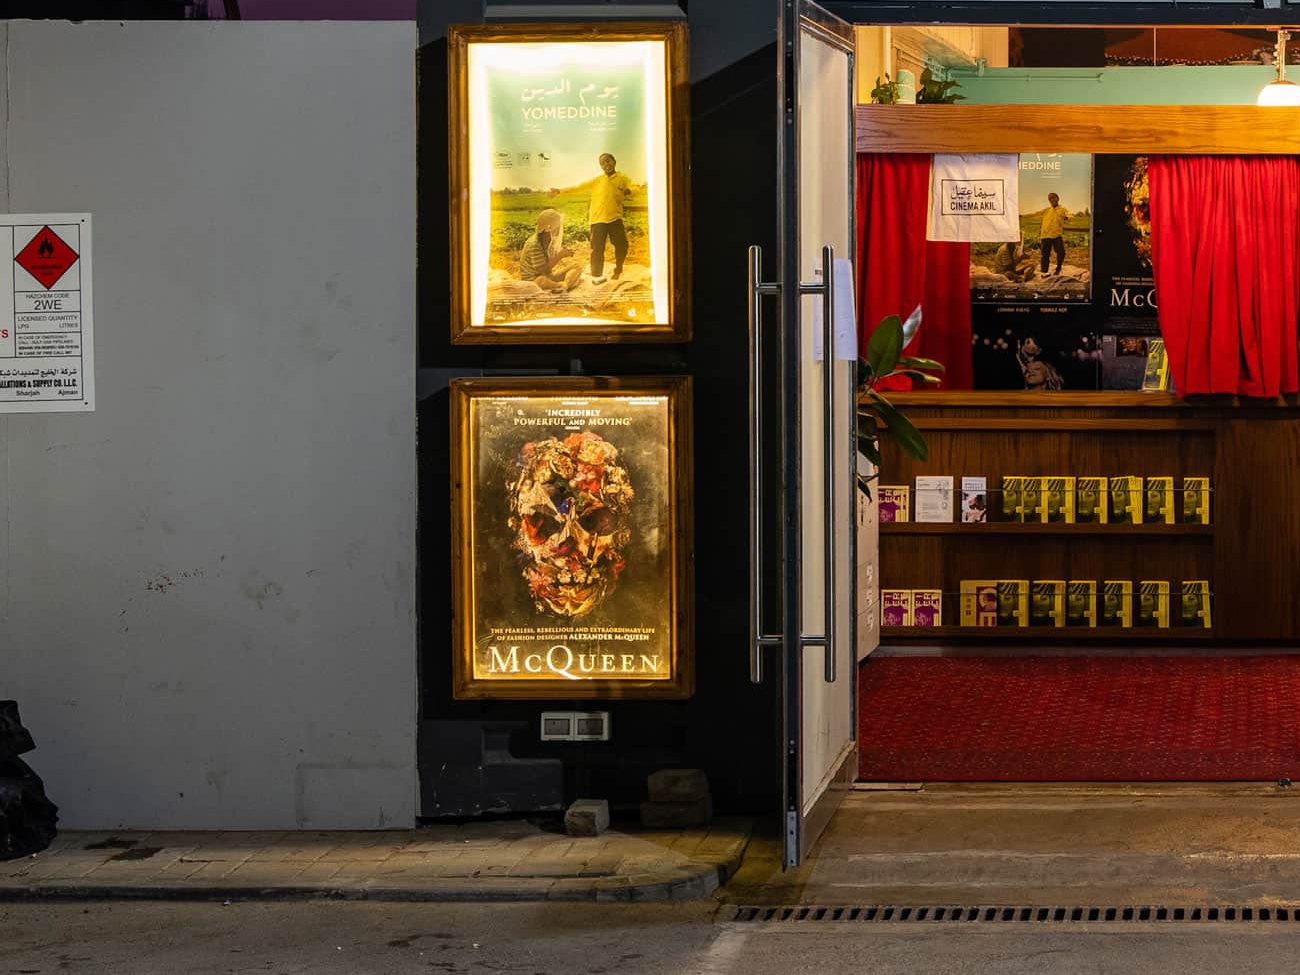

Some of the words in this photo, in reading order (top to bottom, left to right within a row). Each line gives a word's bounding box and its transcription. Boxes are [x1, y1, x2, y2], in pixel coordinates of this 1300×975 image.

[521, 105, 617, 121] YOMEDDINE
[950, 201, 979, 211] CINEMA
[980, 201, 997, 211] AKIL
[33, 299, 63, 311] 2WE
[513, 417, 566, 426] POWERFUL
